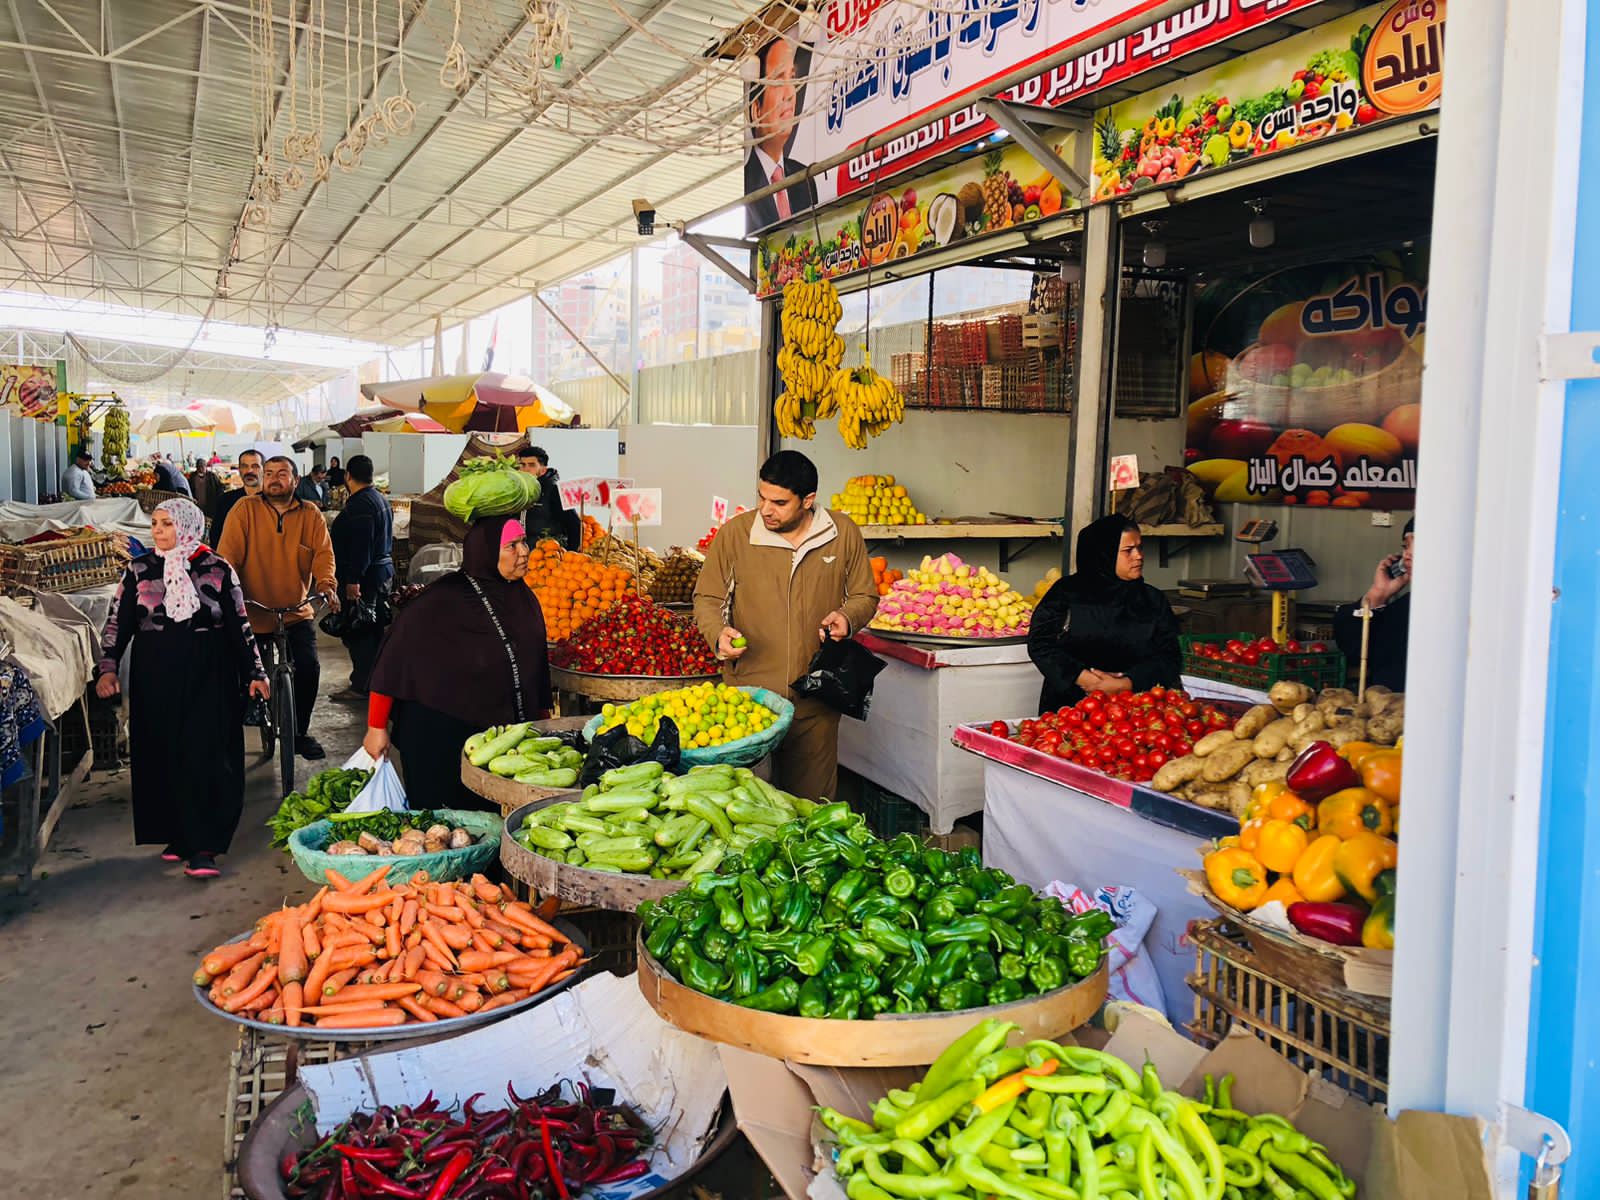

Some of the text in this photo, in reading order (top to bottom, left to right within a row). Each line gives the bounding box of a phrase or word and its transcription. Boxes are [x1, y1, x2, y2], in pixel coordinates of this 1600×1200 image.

[1261, 86, 1358, 141] واحد بس
[1302, 274, 1428, 338] واكه
[1249, 458, 1277, 493] الباز
[1281, 458, 1338, 492] كمال
